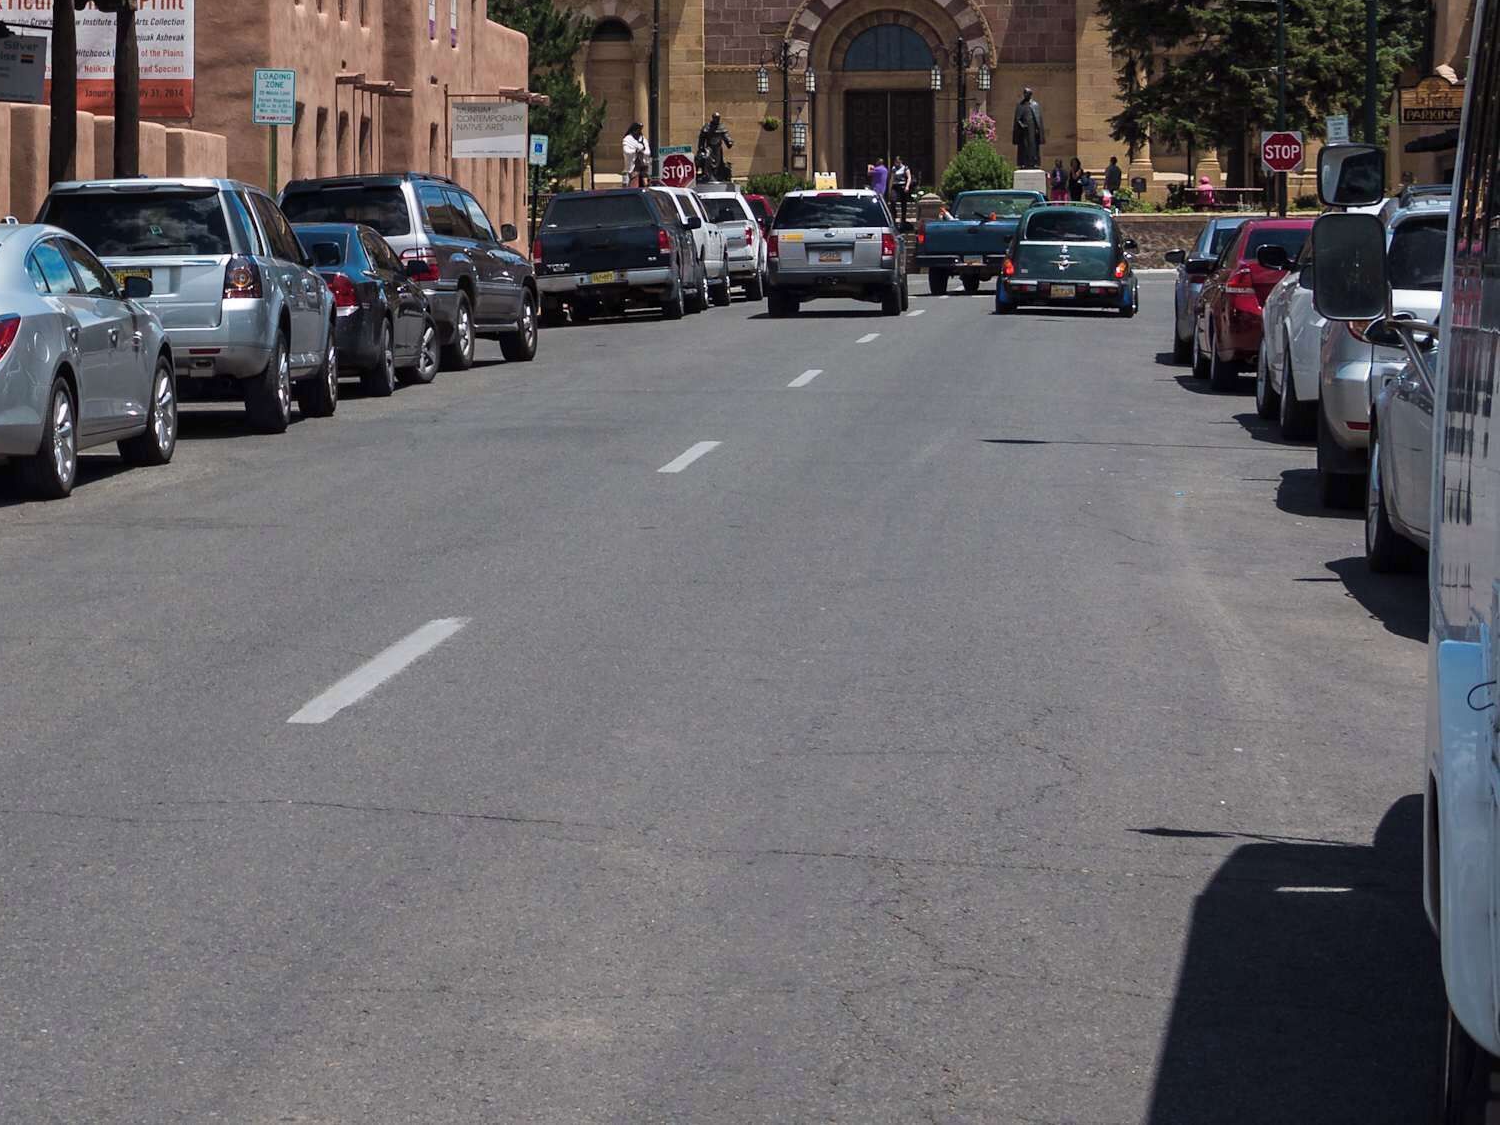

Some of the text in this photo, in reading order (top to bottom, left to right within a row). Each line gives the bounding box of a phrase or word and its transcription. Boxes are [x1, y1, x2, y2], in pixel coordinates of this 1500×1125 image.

[83, 18, 112, 26] Institute
[150, 18, 185, 26] Collection
[156, 34, 185, 42] Ashevak
[456, 115, 523, 123] CONTEMPORARY
[1406, 109, 1460, 120] PARKING
[1265, 144, 1299, 160] STOP
[663, 165, 692, 180] STOP
